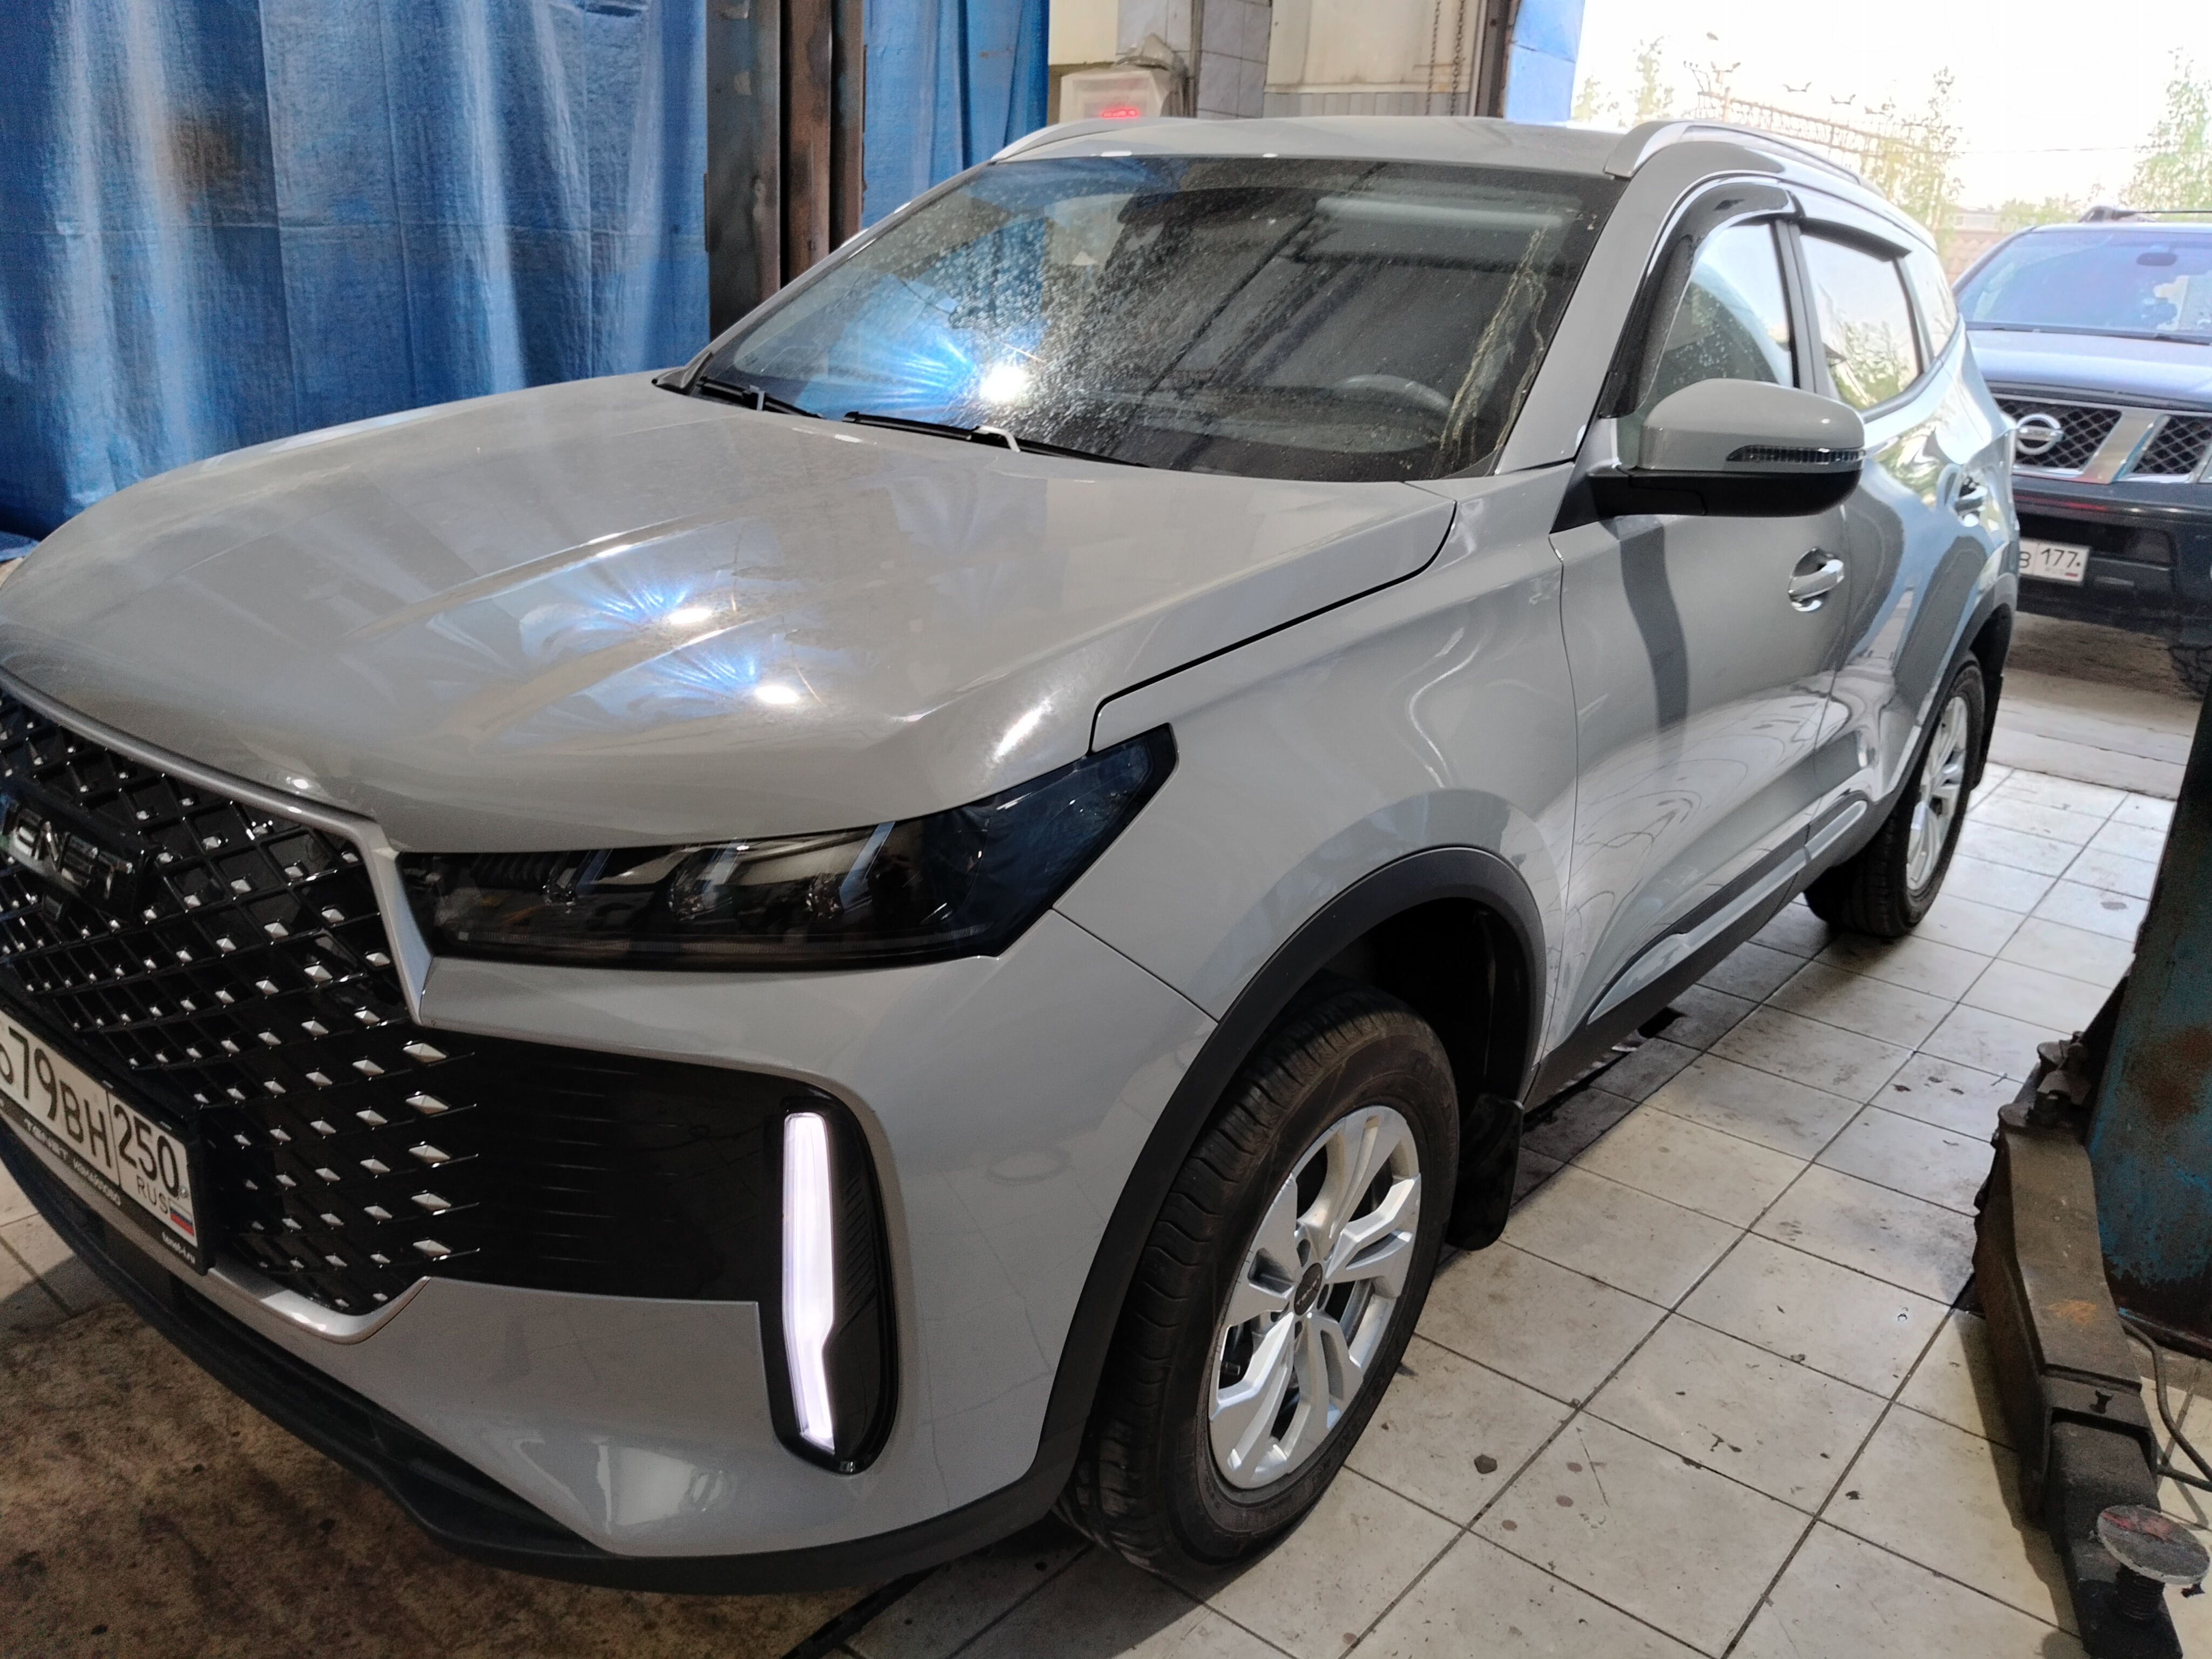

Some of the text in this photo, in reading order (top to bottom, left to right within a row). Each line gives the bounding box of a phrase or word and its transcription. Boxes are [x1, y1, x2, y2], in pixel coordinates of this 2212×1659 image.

[2040, 548, 2078, 569] 177
[114, 1104, 179, 1198] 250
[136, 1174, 168, 1215] RUS
